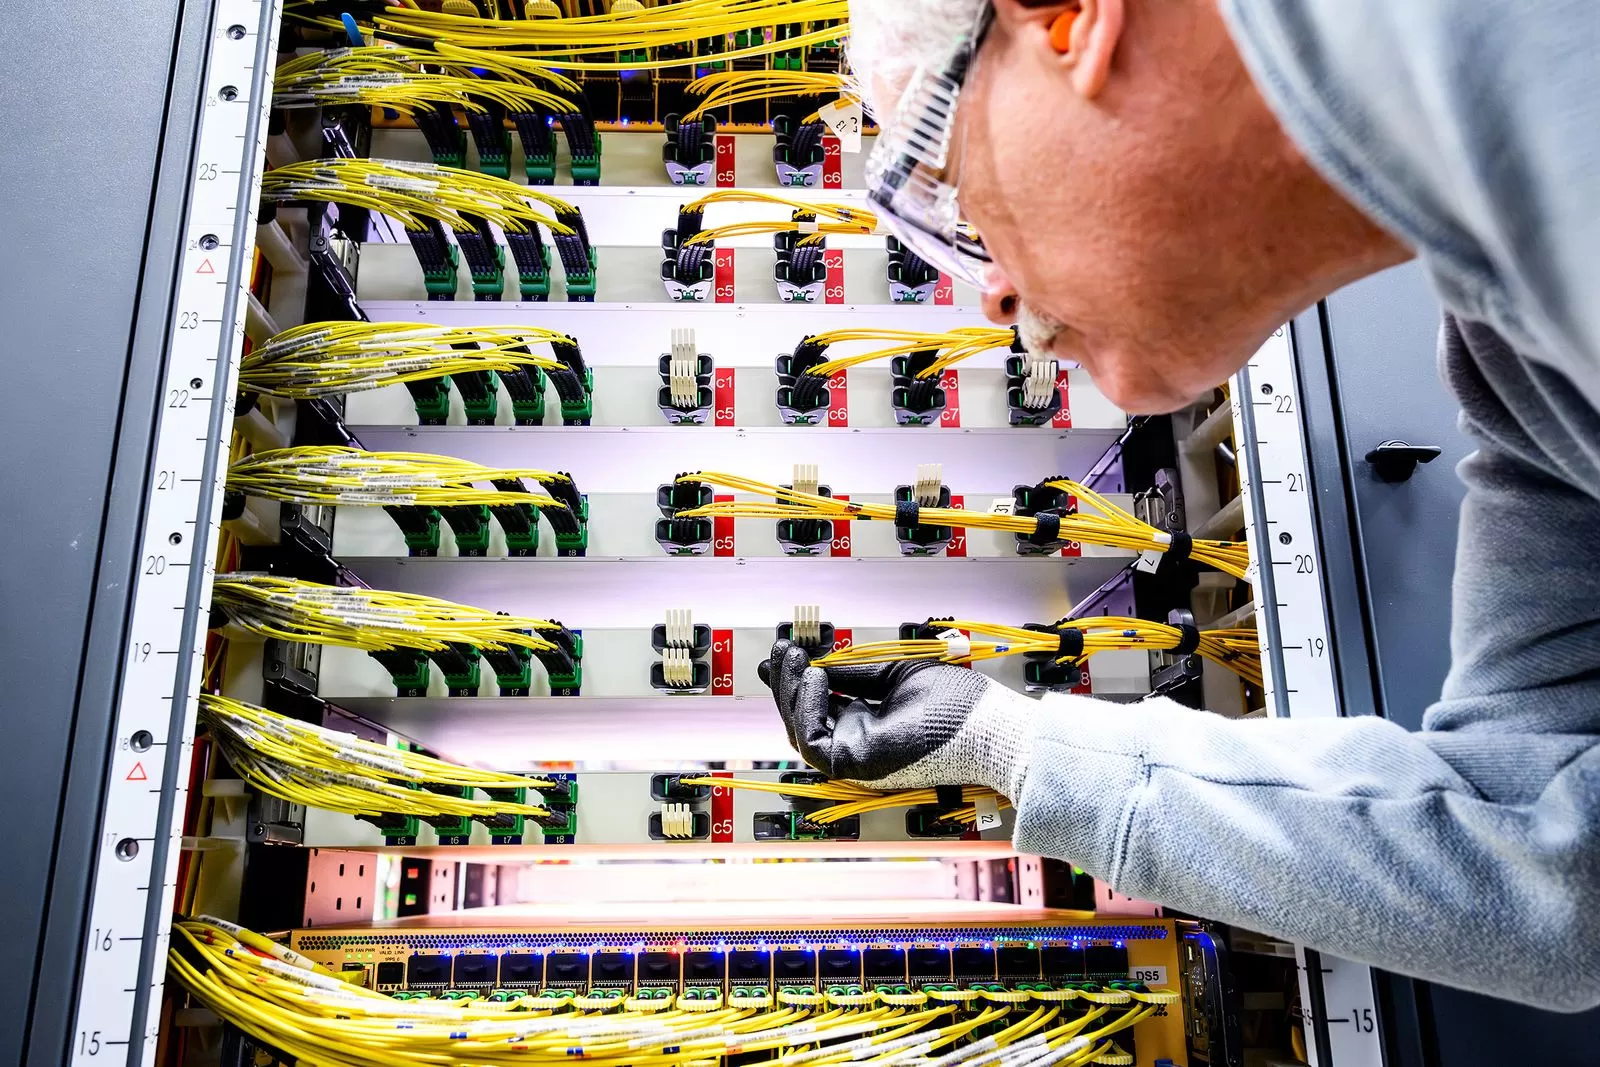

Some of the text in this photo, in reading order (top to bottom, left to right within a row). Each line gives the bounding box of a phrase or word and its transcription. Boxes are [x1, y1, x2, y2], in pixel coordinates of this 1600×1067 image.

[835, 120, 847, 132] 13
[717, 143, 734, 154] c1
[824, 144, 841, 155] c2
[199, 163, 218, 181] 25
[717, 171, 735, 182] c5
[824, 172, 841, 183] c6
[716, 256, 732, 267] c1
[826, 257, 843, 268] c2
[716, 285, 734, 297] c5
[826, 286, 843, 298] c6
[935, 287, 952, 298] c7
[180, 312, 198, 330] 23
[717, 376, 733, 388] c1
[829, 376, 846, 389] c2
[941, 377, 958, 389] c3
[169, 389, 189, 409] 22
[1274, 395, 1293, 413] 22
[716, 408, 734, 420] c5
[829, 409, 847, 421] c6
[941, 408, 959, 421] c7
[1053, 408, 1070, 421] c8
[573, 418, 582, 426] t8
[157, 470, 175, 490] 21
[1286, 473, 1304, 492] 21
[994, 504, 1011, 514] 31
[715, 536, 734, 549] c5
[832, 536, 850, 549] c6
[948, 536, 965, 549] c7
[145, 555, 166, 575] 20
[1295, 554, 1314, 574] 20
[713, 638, 731, 652] c1
[833, 638, 851, 652] c2
[1307, 638, 1324, 658] 19
[133, 642, 152, 663] 19
[713, 673, 732, 688] c5
[408, 688, 417, 696] t5
[460, 688, 468, 696] t6
[511, 688, 520, 696] t7
[562, 688, 571, 696] t8
[713, 785, 730, 796] c1
[981, 814, 994, 824] 22
[712, 819, 733, 834] c5
[397, 836, 407, 844] t5
[450, 836, 459, 844] t6
[503, 836, 512, 844] t7
[556, 835, 565, 843] t8
[95, 928, 113, 951] 16
[1135, 970, 1160, 981] DS5
[1353, 1008, 1374, 1033] 15
[79, 1031, 102, 1056] 15
